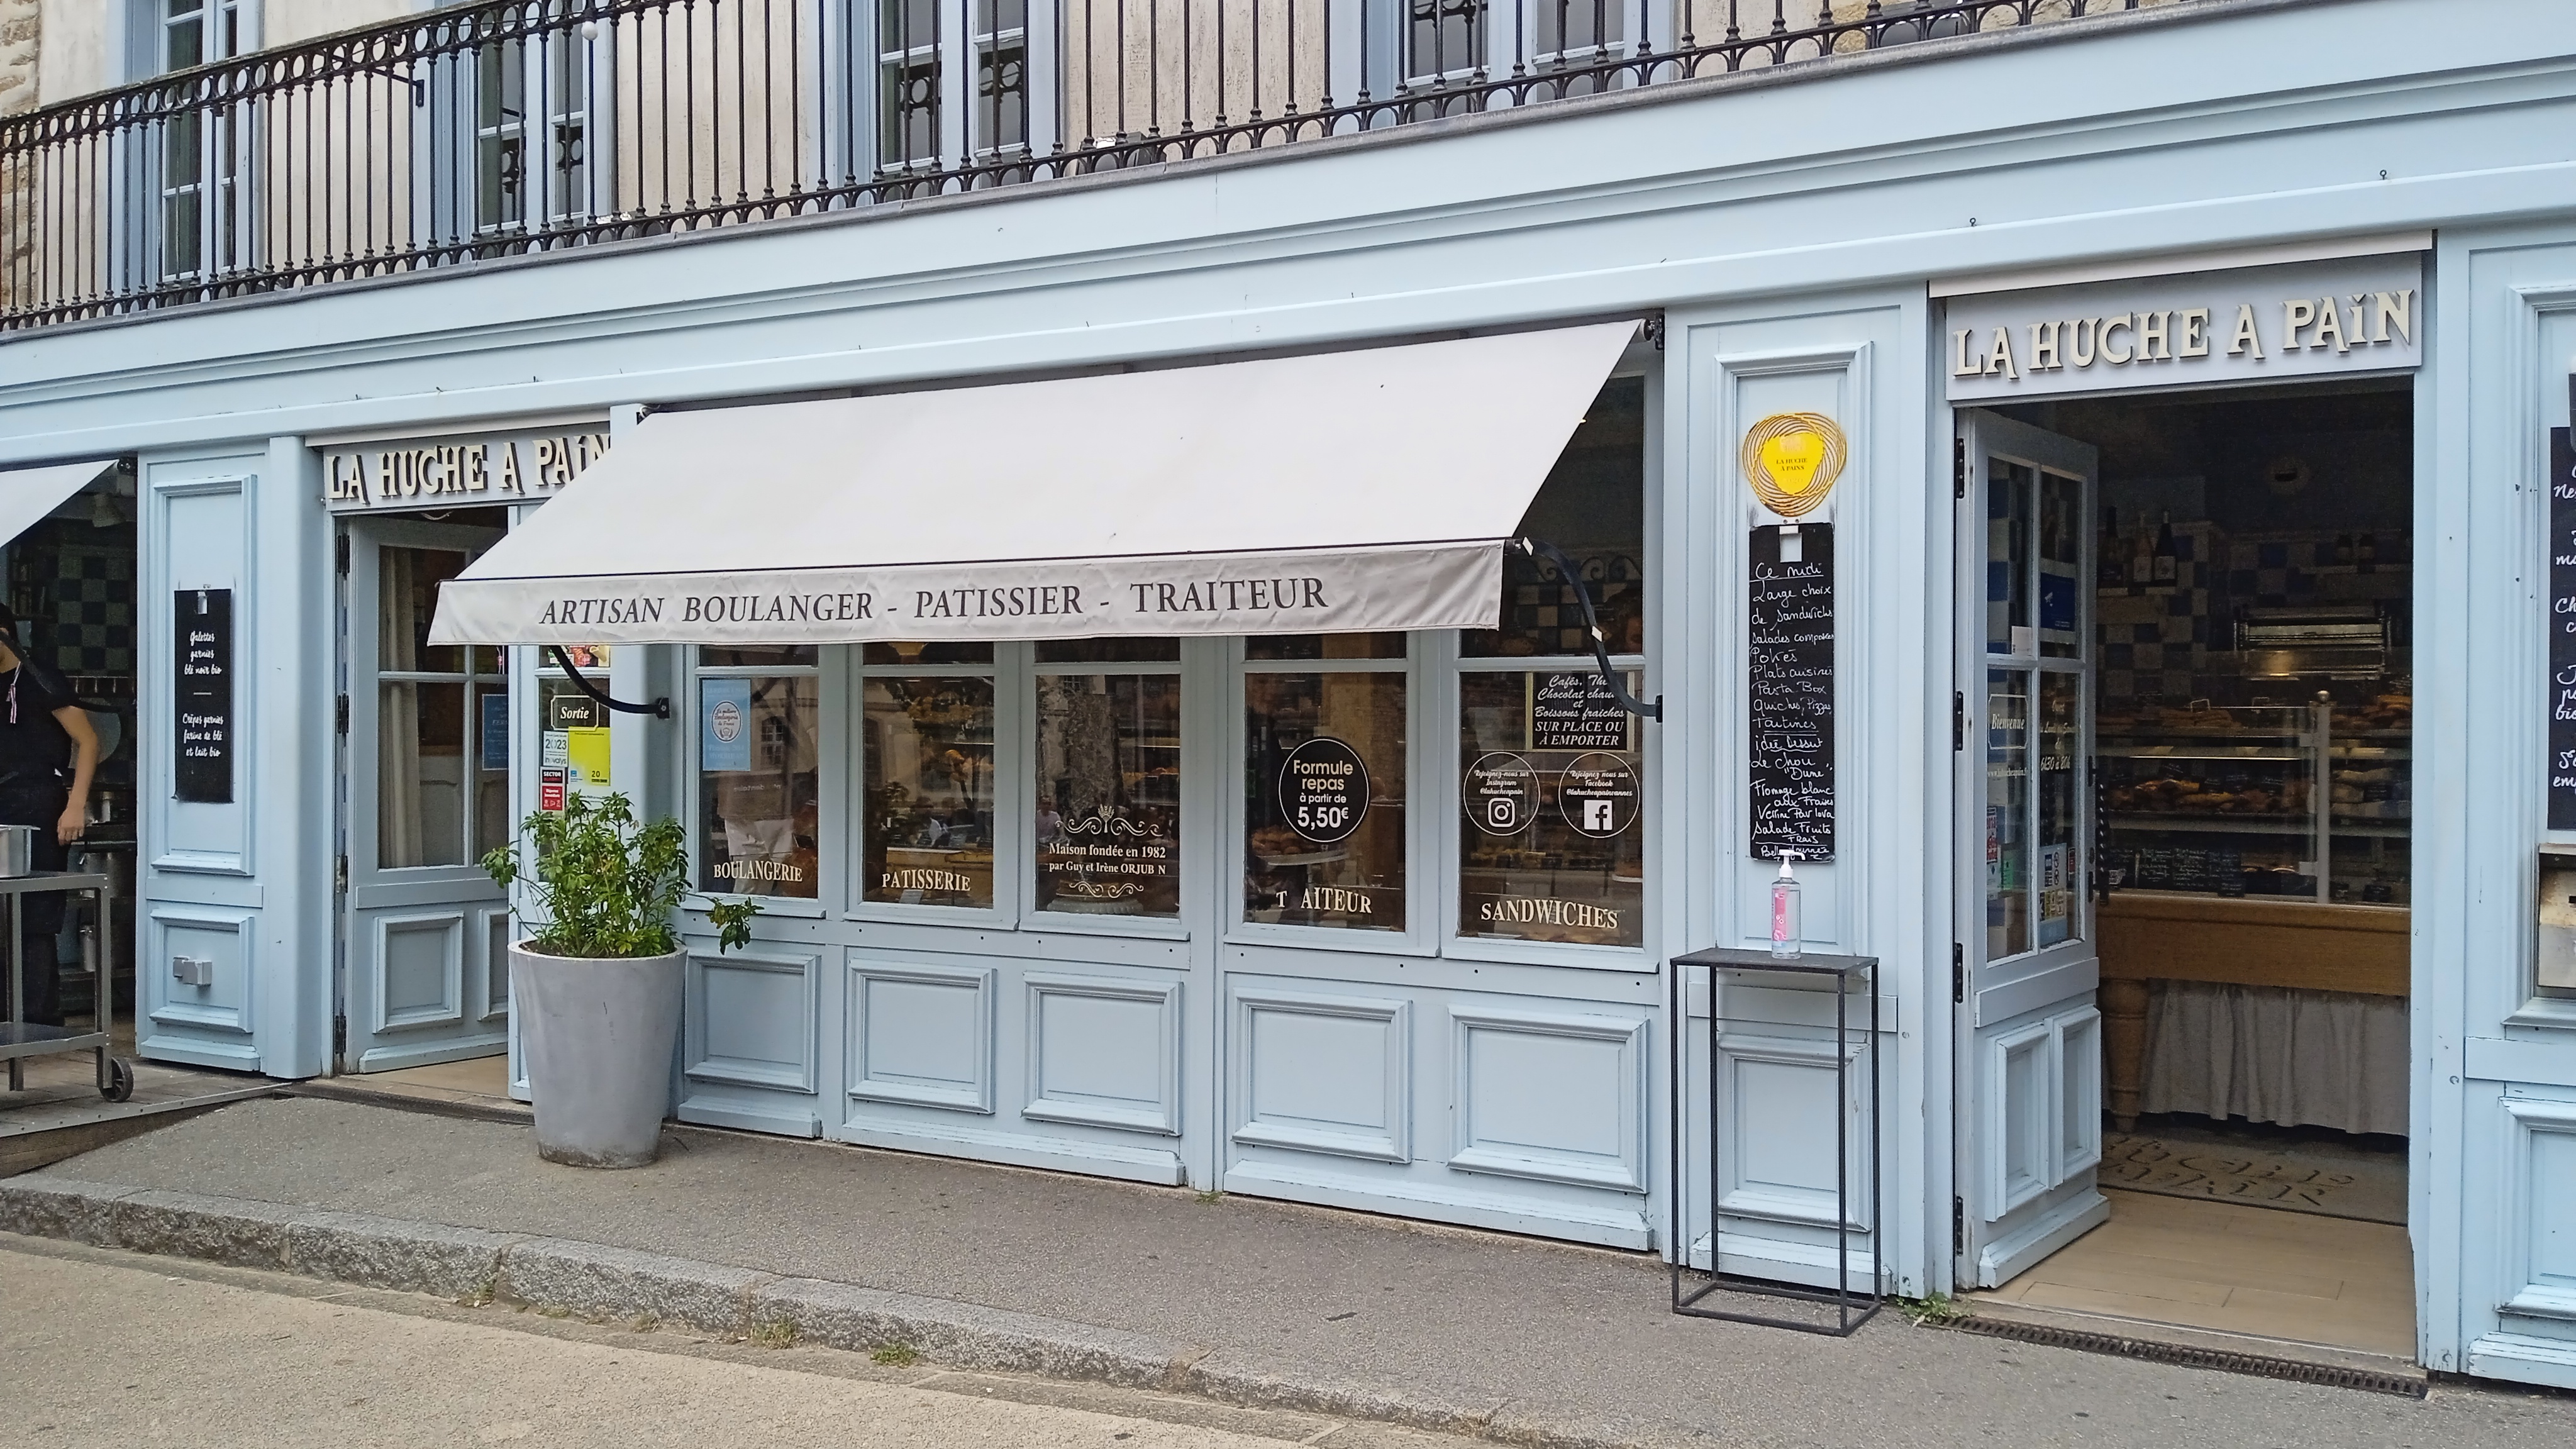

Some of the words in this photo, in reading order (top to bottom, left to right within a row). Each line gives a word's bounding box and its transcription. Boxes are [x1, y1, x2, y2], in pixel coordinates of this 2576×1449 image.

[1953, 326, 2019, 380] LA
[2026, 308, 2210, 372] HUCHE
[2226, 304, 2265, 361] A
[326, 455, 370, 506] LA
[377, 444, 489, 497] HUCHE
[499, 442, 525, 495] A
[1755, 562, 1779, 579] Ce
[1802, 583, 1831, 597] choix
[539, 597, 665, 625] ARTISAN
[682, 592, 873, 623] BOULANGER
[914, 585, 1084, 618] PATISSIER
[1130, 577, 1328, 613] TRAITEUR
[1752, 608, 1768, 625] de
[211, 663, 222, 675] bio
[1749, 663, 1786, 680] Plats
[1538, 687, 1584, 700] Chocolat
[1587, 688, 1615, 699] chau
[1752, 680, 1797, 696] Pasta
[1796, 680, 1827, 695] Box
[1573, 699, 1584, 708] et
[560, 706, 590, 719] Sortie
[1535, 706, 1579, 718] Boissons
[1535, 721, 1560, 732] SUR
[1562, 721, 1602, 732] PLACE
[1605, 721, 1624, 732] OU
[1752, 716, 1817, 730] Tartines
[1991, 714, 2025, 730] Bienvenue
[1539, 732, 1548, 745] À
[1551, 735, 1619, 746] EMPORTER
[209, 746, 221, 757] bio
[1750, 749, 1772, 769] Le
[1293, 760, 1353, 775] Formule
[1301, 777, 1345, 792] repas
[1485, 779, 1517, 788] Instagram
[1801, 780, 1835, 795] blanc
[1299, 792, 1306, 802] à
[1308, 794, 1332, 804] partir
[1335, 794, 1347, 803] de
[1297, 807, 1349, 830] 5,50€
[1794, 821, 1831, 834] Fruits
[1049, 843, 1087, 855] Maison
[1089, 845, 1124, 857] fondée
[1126, 848, 1138, 857] en
[1141, 846, 1166, 858] 1982
[1761, 845, 1780, 857] Bell
[713, 860, 803, 882] BOULANGERIE
[1049, 863, 1064, 872] par
[1066, 861, 1084, 874] Guy
[1085, 863, 1094, 872] et
[1096, 862, 1119, 872] Irène
[881, 869, 971, 892] PATISSERIE
[1480, 899, 1619, 929] SANDWICHES
